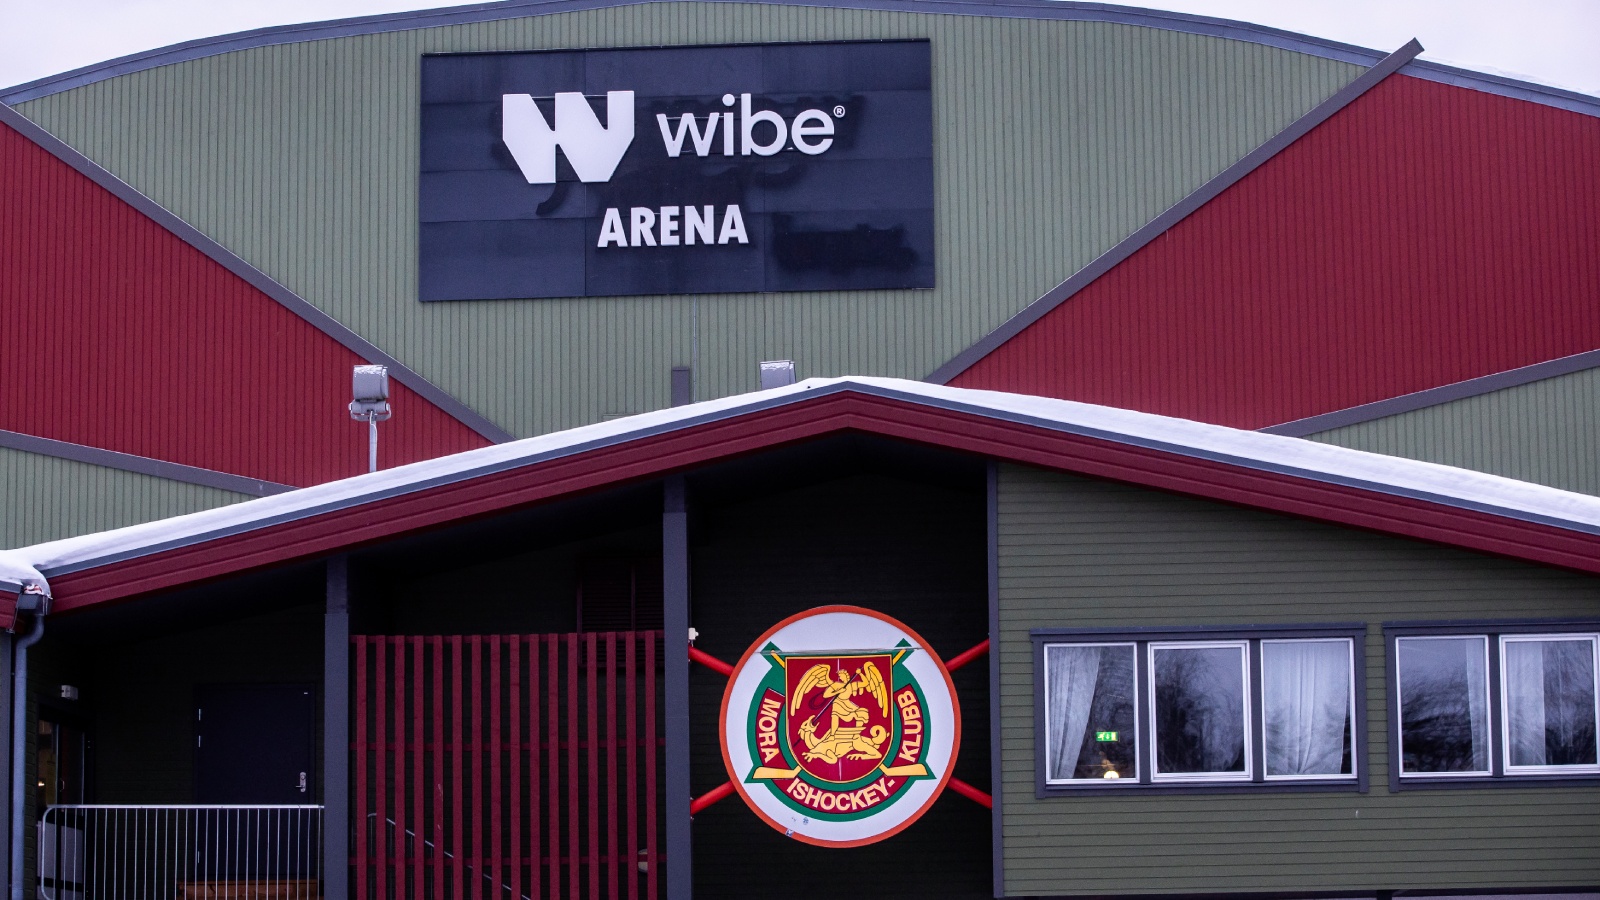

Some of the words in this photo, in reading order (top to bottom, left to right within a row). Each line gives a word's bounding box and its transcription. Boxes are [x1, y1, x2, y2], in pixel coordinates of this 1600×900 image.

[597, 204, 749, 247] ARENA
[758, 698, 782, 763] MORA
[786, 778, 895, 811] ISHOCKEY-
[898, 691, 922, 762] KLUBB
